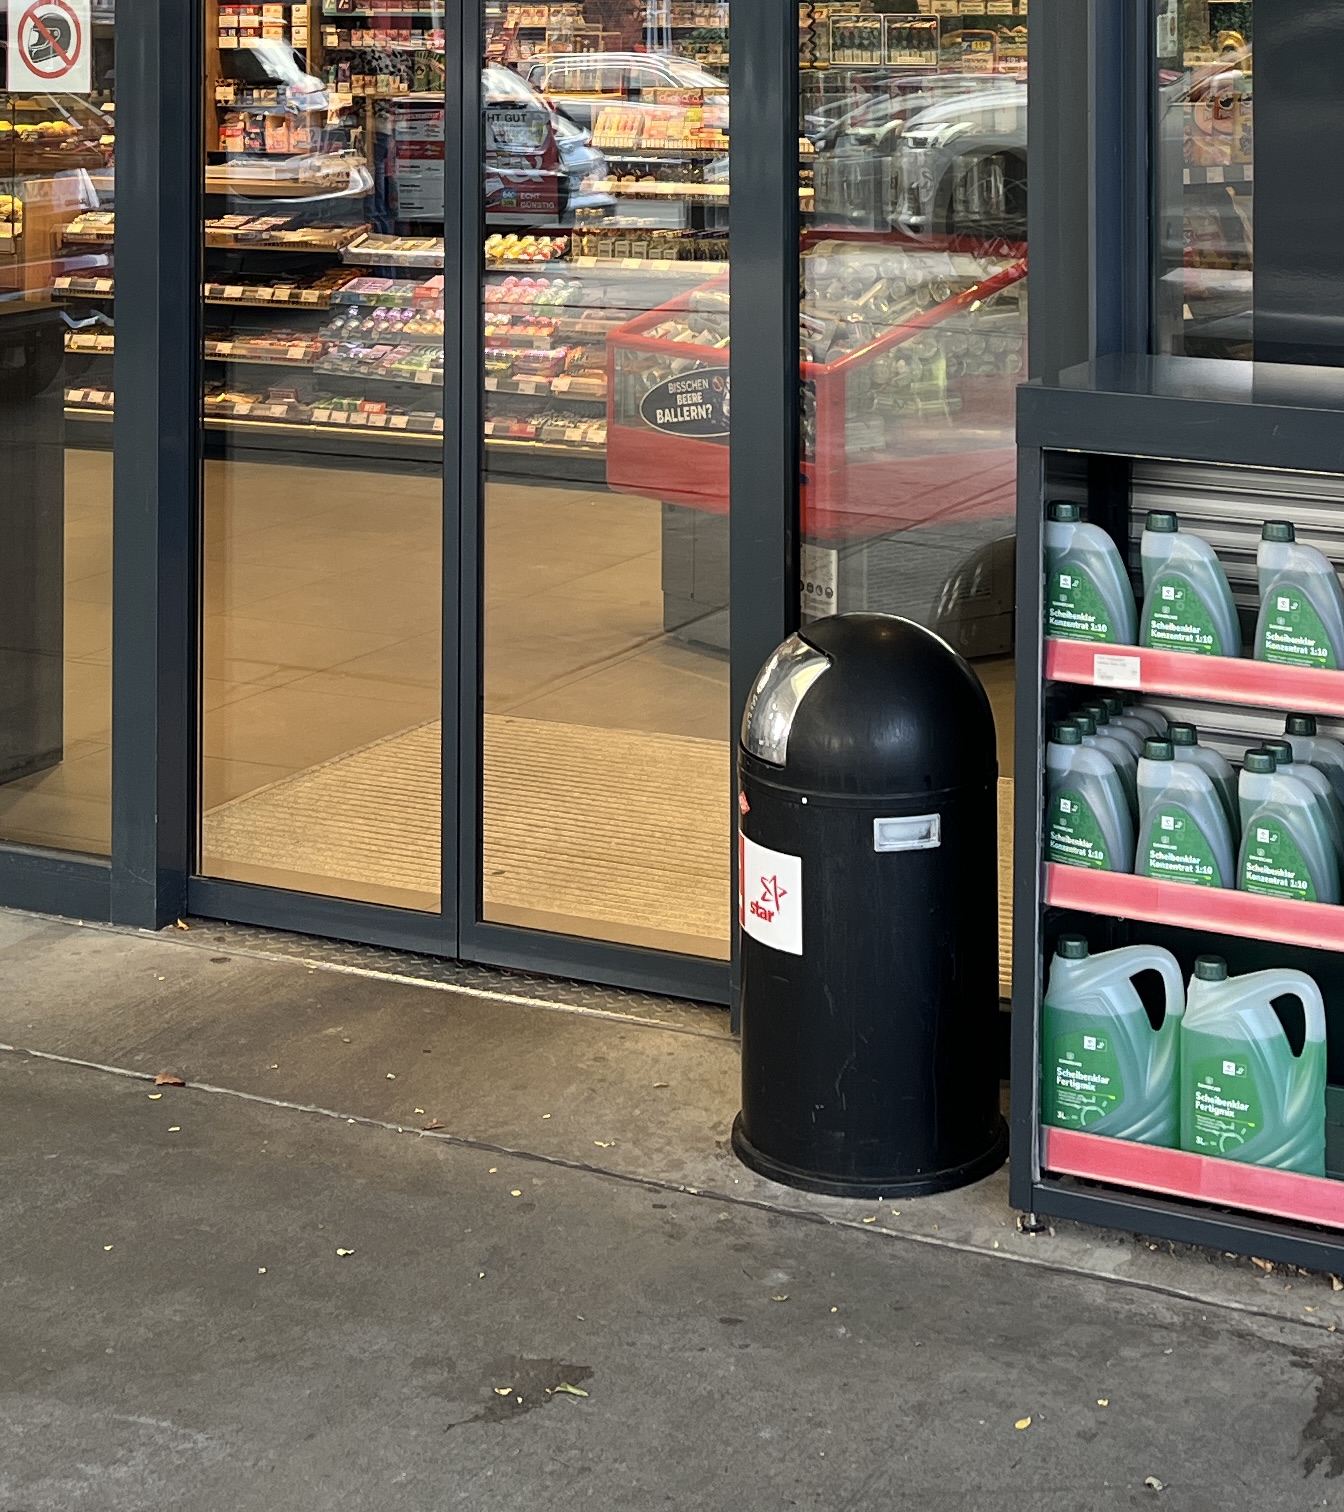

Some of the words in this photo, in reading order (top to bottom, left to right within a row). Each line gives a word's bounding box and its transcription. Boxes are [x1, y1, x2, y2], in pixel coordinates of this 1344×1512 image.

[504, 113, 527, 122] GUT
[520, 200, 555, 209] GÜNSTIG
[667, 378, 709, 394] BISSCHEN
[676, 392, 703, 405] BEERE
[656, 405, 713, 424] BALLERN?
[749, 900, 775, 923] star
